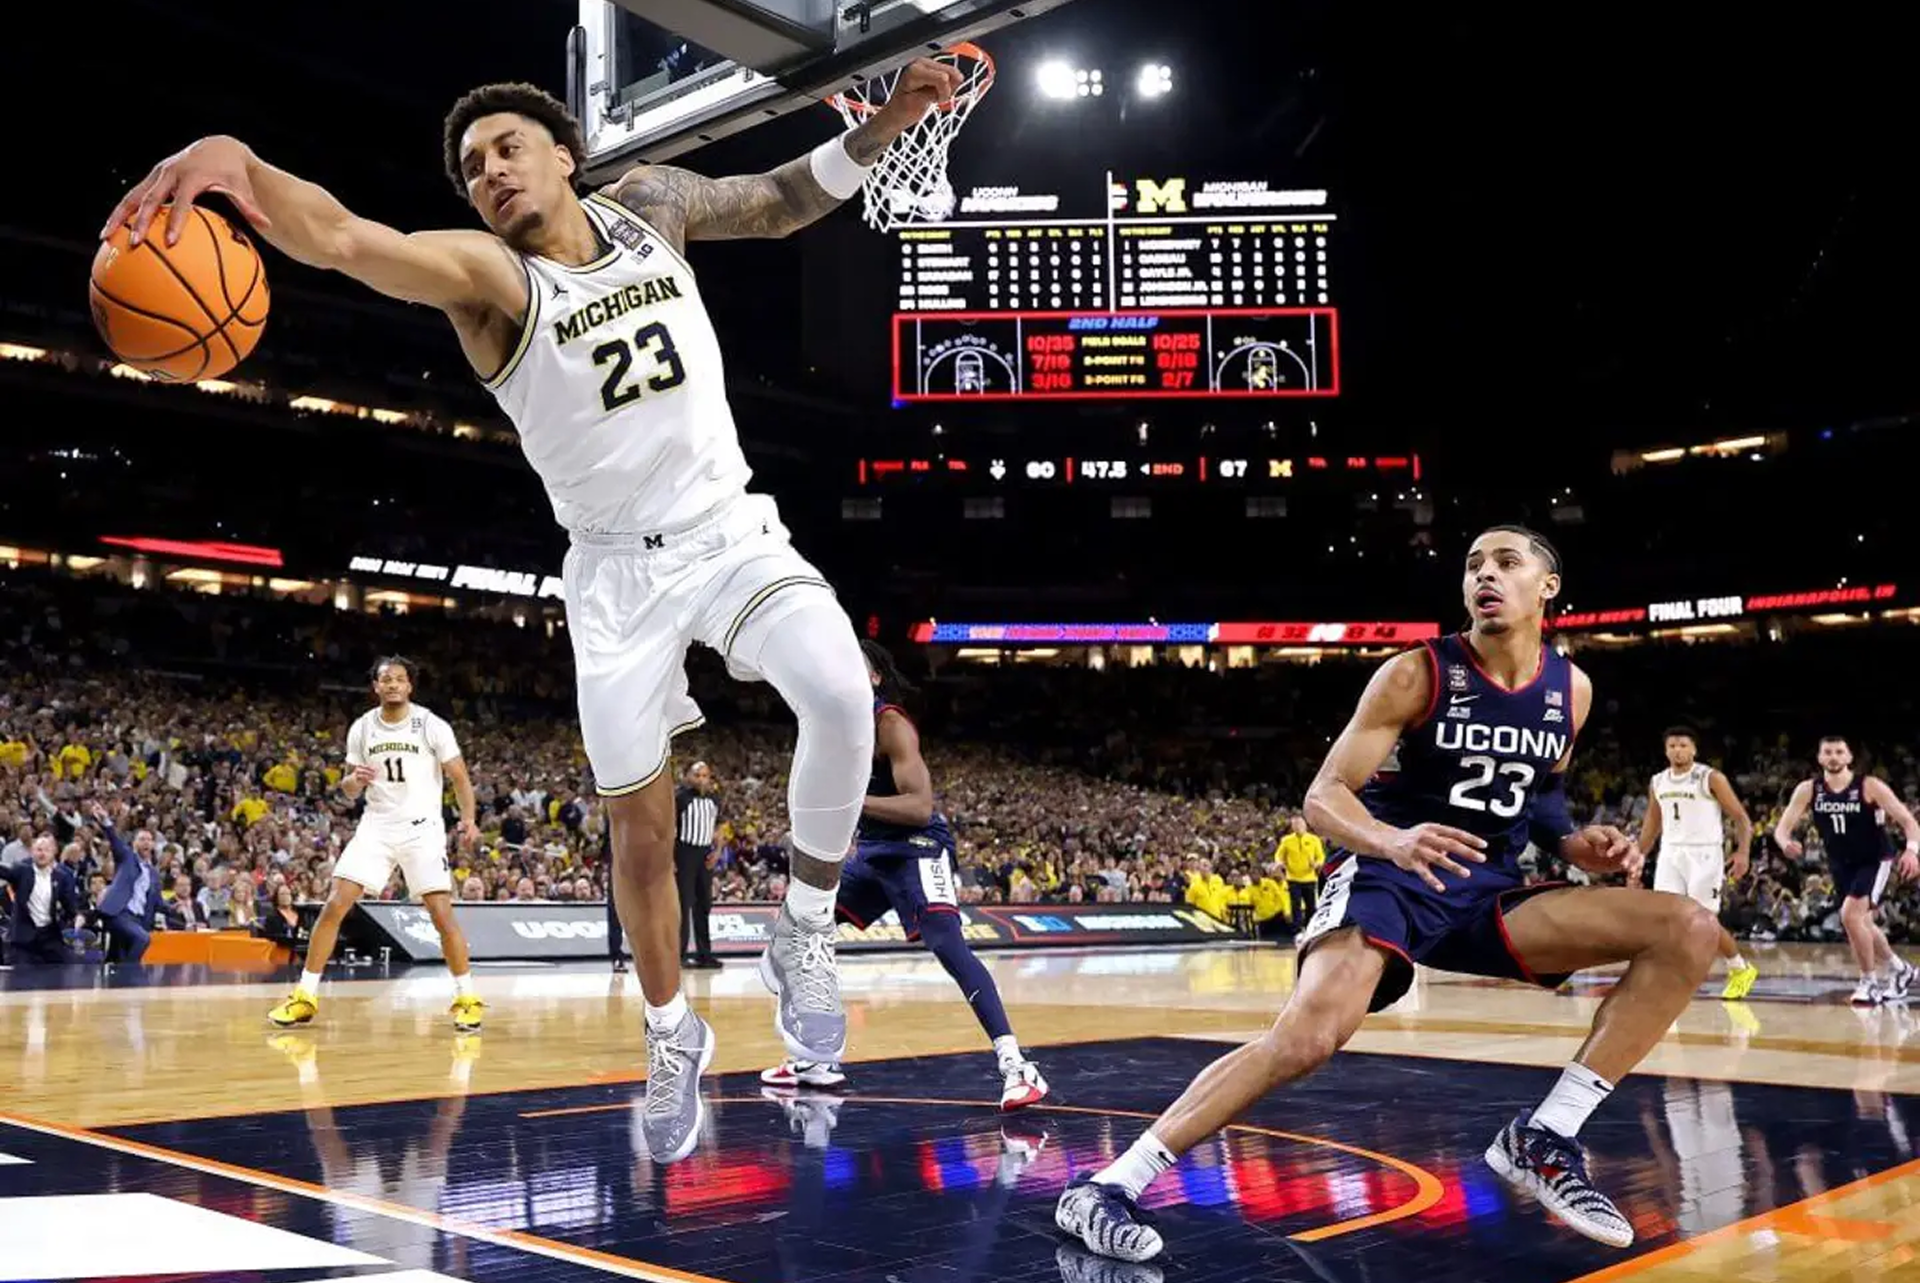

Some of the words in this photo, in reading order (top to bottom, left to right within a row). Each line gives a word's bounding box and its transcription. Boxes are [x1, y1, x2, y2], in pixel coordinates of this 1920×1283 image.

[971, 187, 1019, 199] UCONN
[1135, 179, 1187, 212] M
[1203, 181, 1268, 193] MICHIGAN
[554, 275, 683, 346] MICHIGAN
[1068, 317, 1107, 330] 2ND
[1110, 316, 1158, 329] HALF
[591, 320, 686, 412] 23
[643, 533, 665, 550] M
[1649, 602, 1694, 622] FINAL
[1697, 596, 1743, 617] FOUR
[368, 742, 419, 756] MICHIGAN
[1436, 722, 1566, 760] UCONN
[384, 758, 406, 782] 11
[1449, 755, 1535, 817] 23
[1674, 802, 1680, 820] 1
[1814, 800, 1860, 813] UCONN
[1830, 814, 1846, 834] 11
[931, 860, 948, 898] HUS
